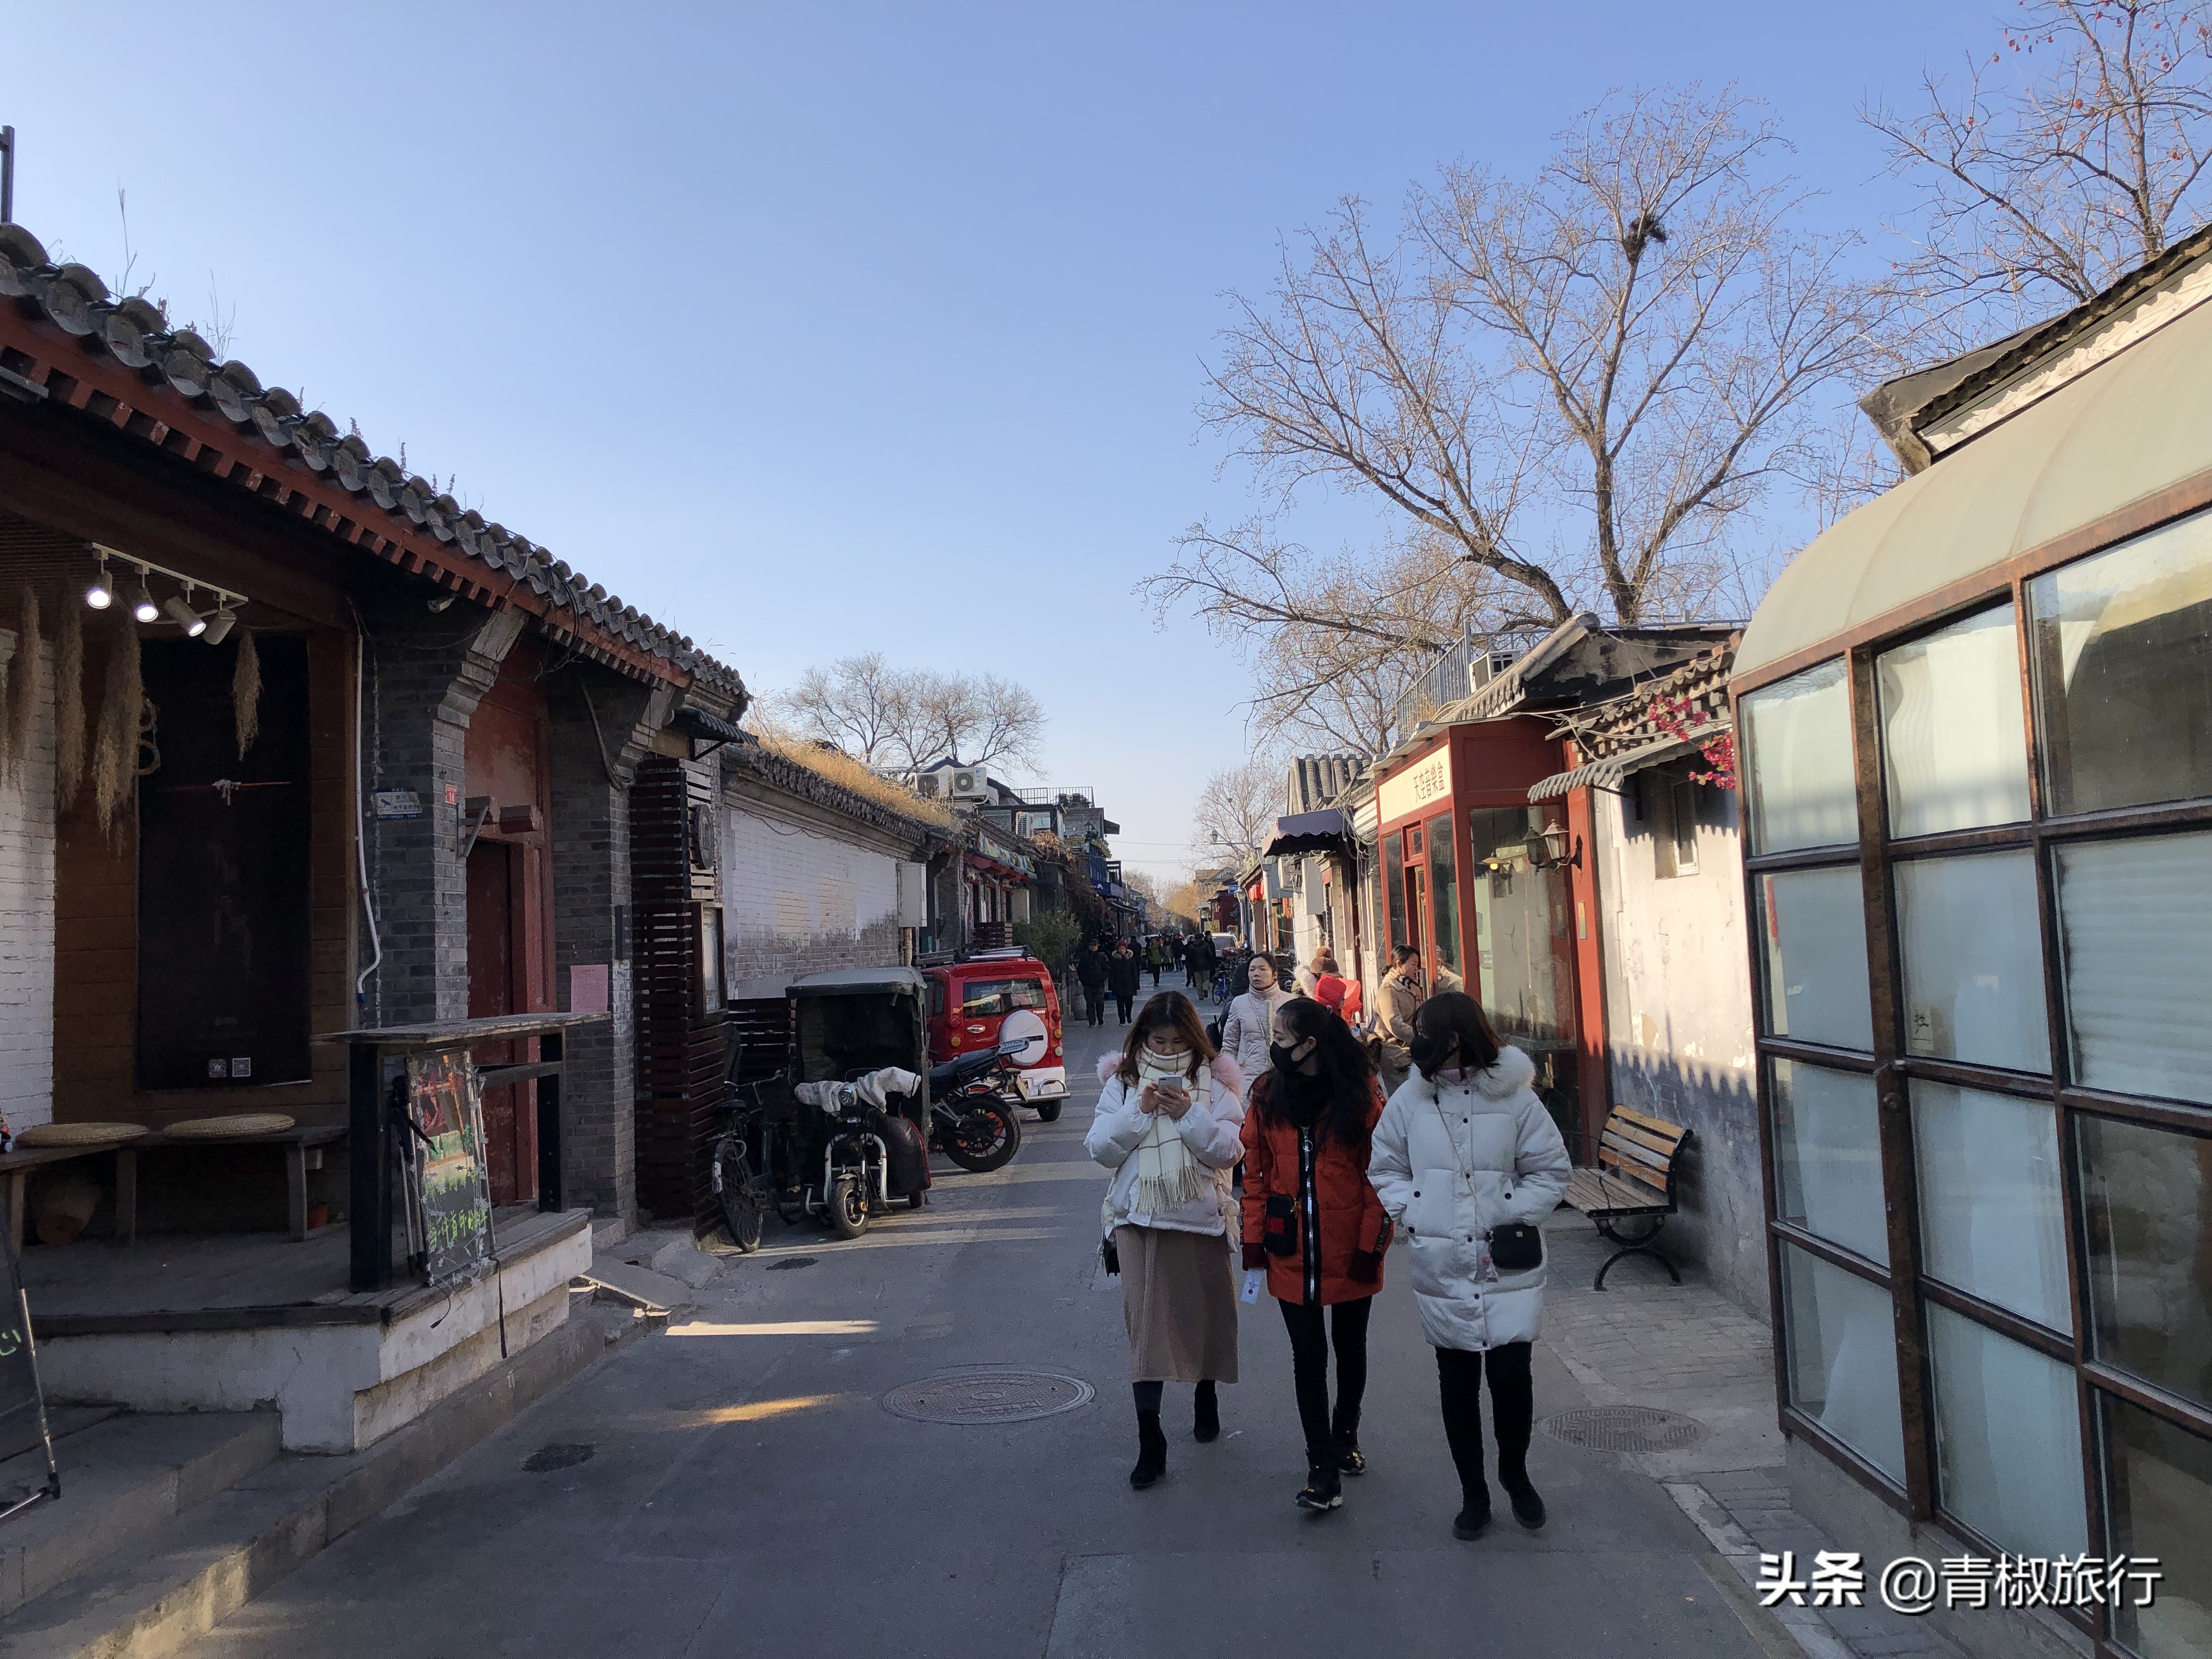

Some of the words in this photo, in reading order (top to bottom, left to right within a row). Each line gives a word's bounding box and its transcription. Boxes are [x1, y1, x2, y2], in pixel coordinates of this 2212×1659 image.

[1413, 761, 1445, 803] 天空音樂盒
